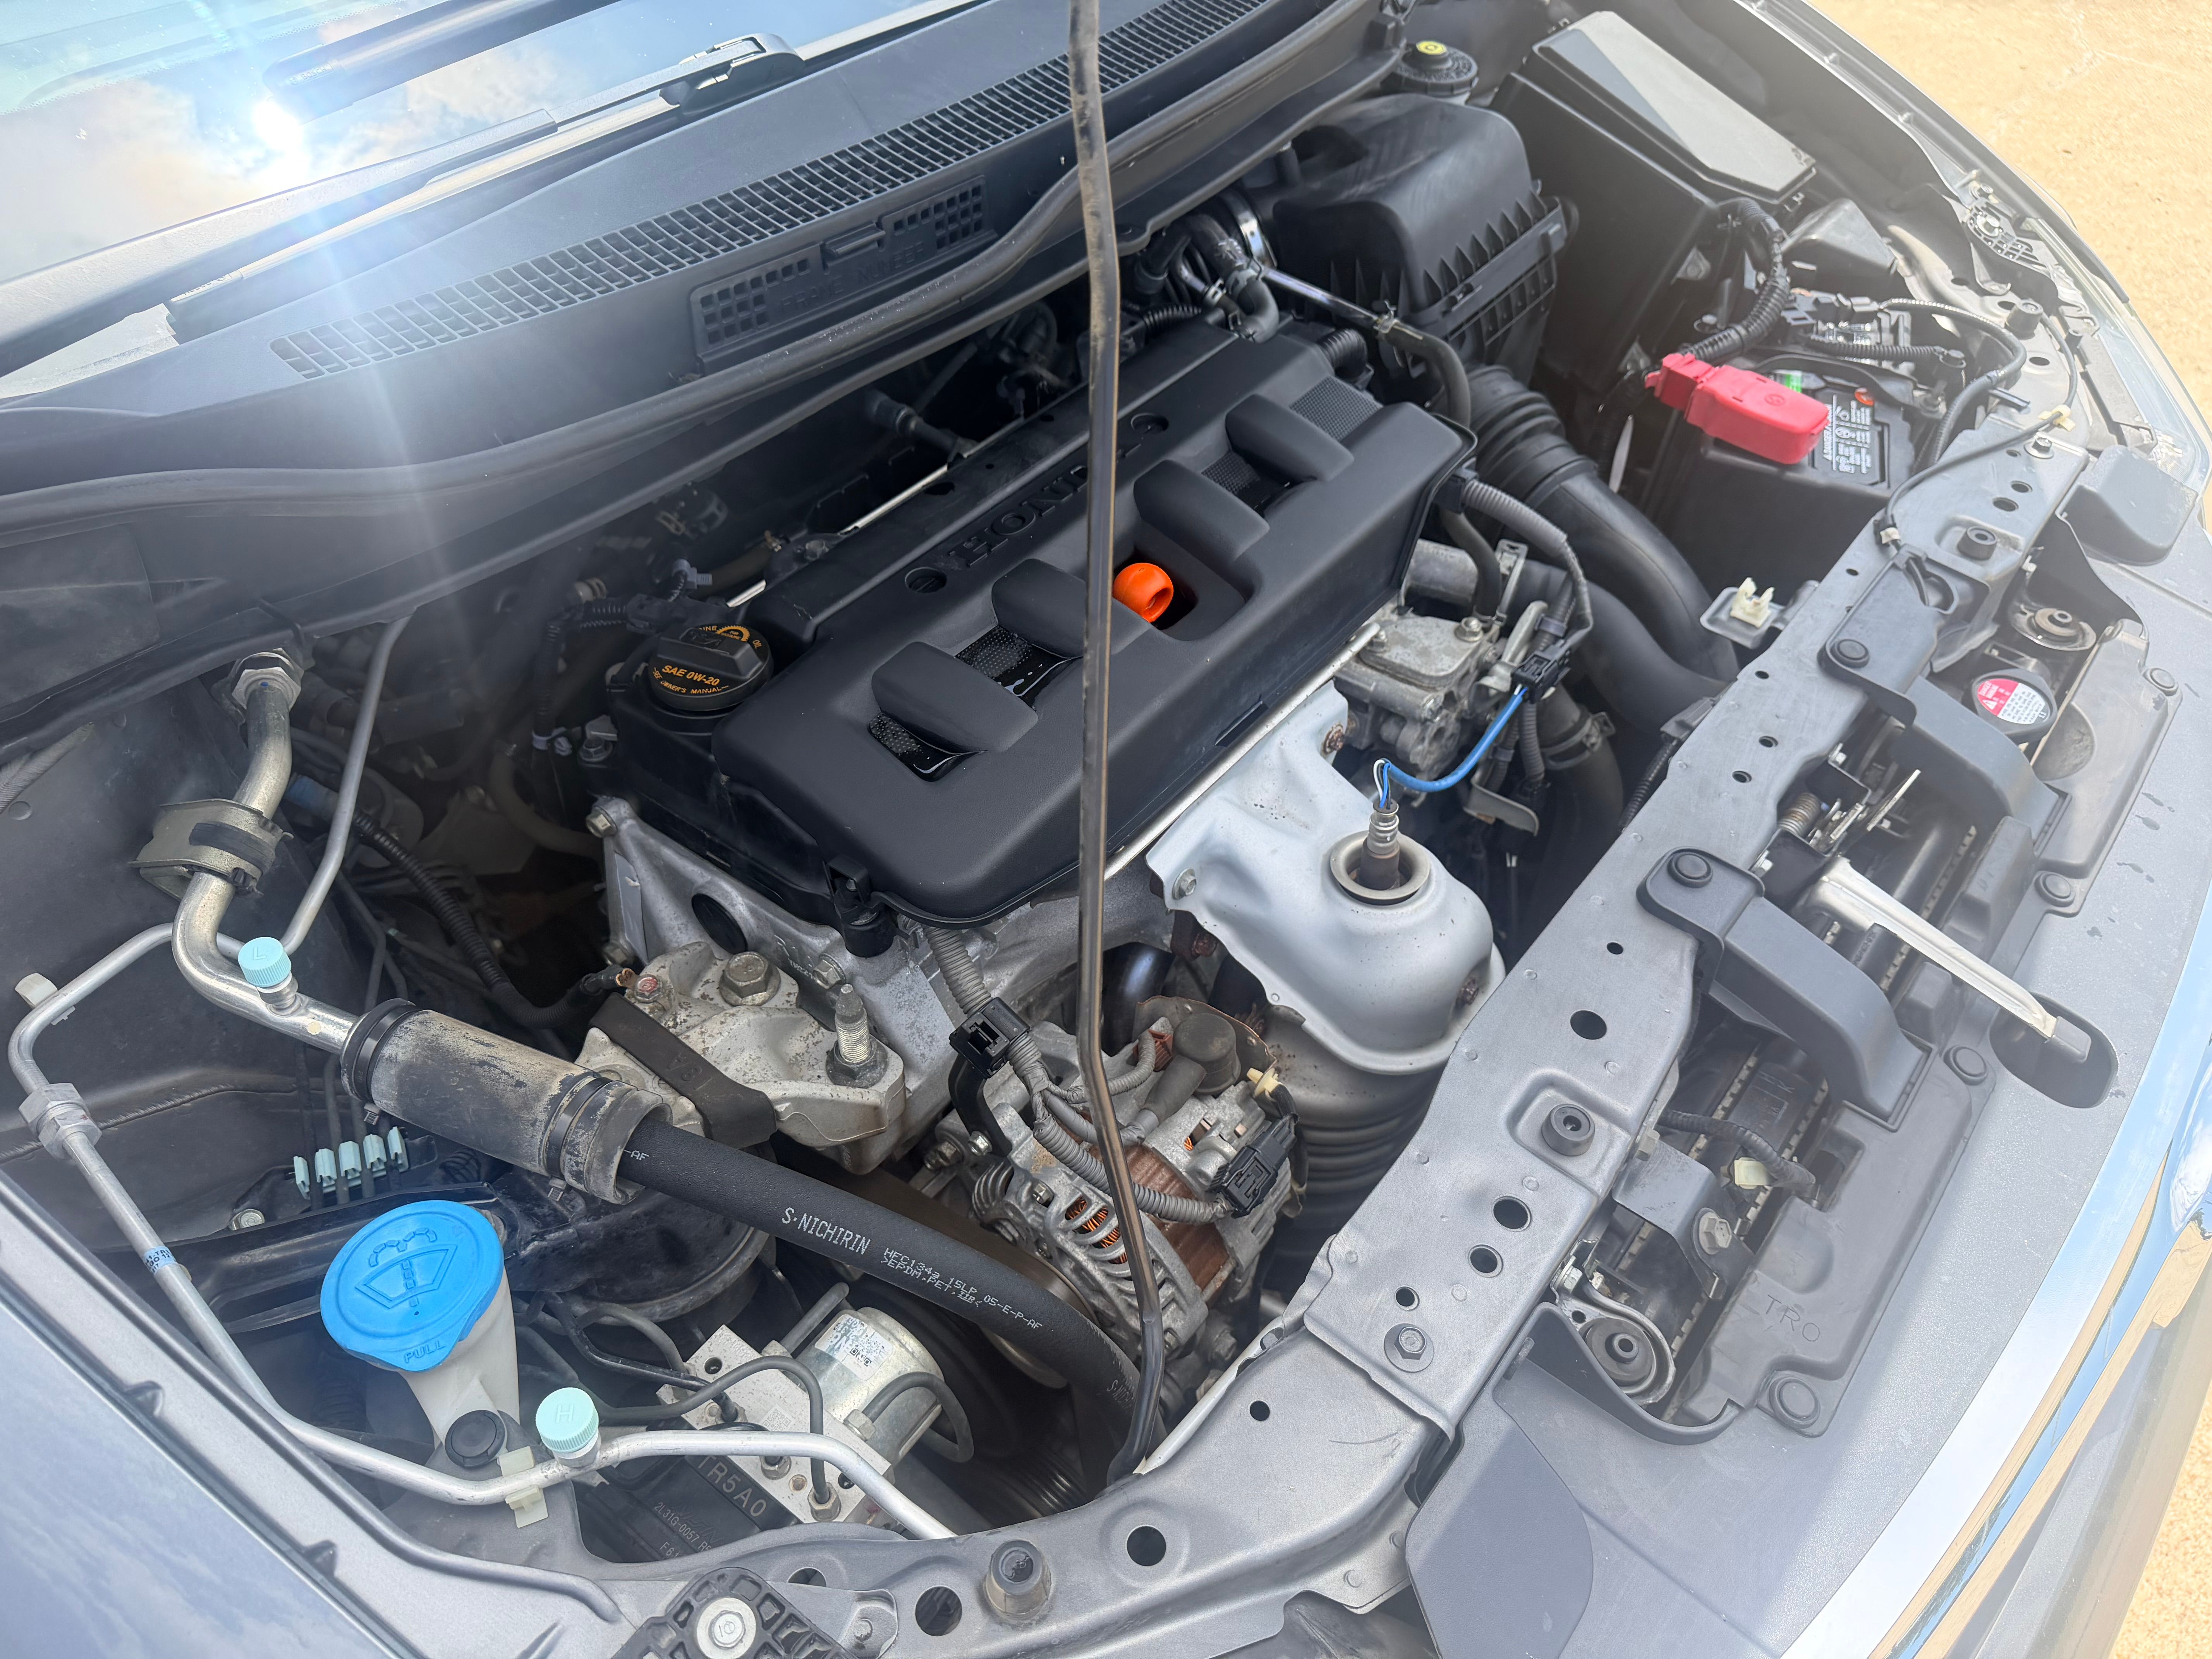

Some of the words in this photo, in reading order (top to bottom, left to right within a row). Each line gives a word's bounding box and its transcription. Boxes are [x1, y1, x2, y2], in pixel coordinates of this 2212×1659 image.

[781, 275, 845, 308] FRAME
[857, 241, 925, 283] NUMBER
[950, 443, 1141, 568] HOND
[752, 639, 763, 649] OIL
[660, 680, 687, 693] OWNER'S
[661, 665, 687, 677] SAE
[686, 672, 720, 686] 0W-20
[252, 946, 267, 961] L
[404, 1340, 447, 1364] PULL
[556, 1403, 575, 1423] H
[698, 1455, 767, 1517] TR5A0
[654, 1502, 700, 1543] 2L31G-0057
